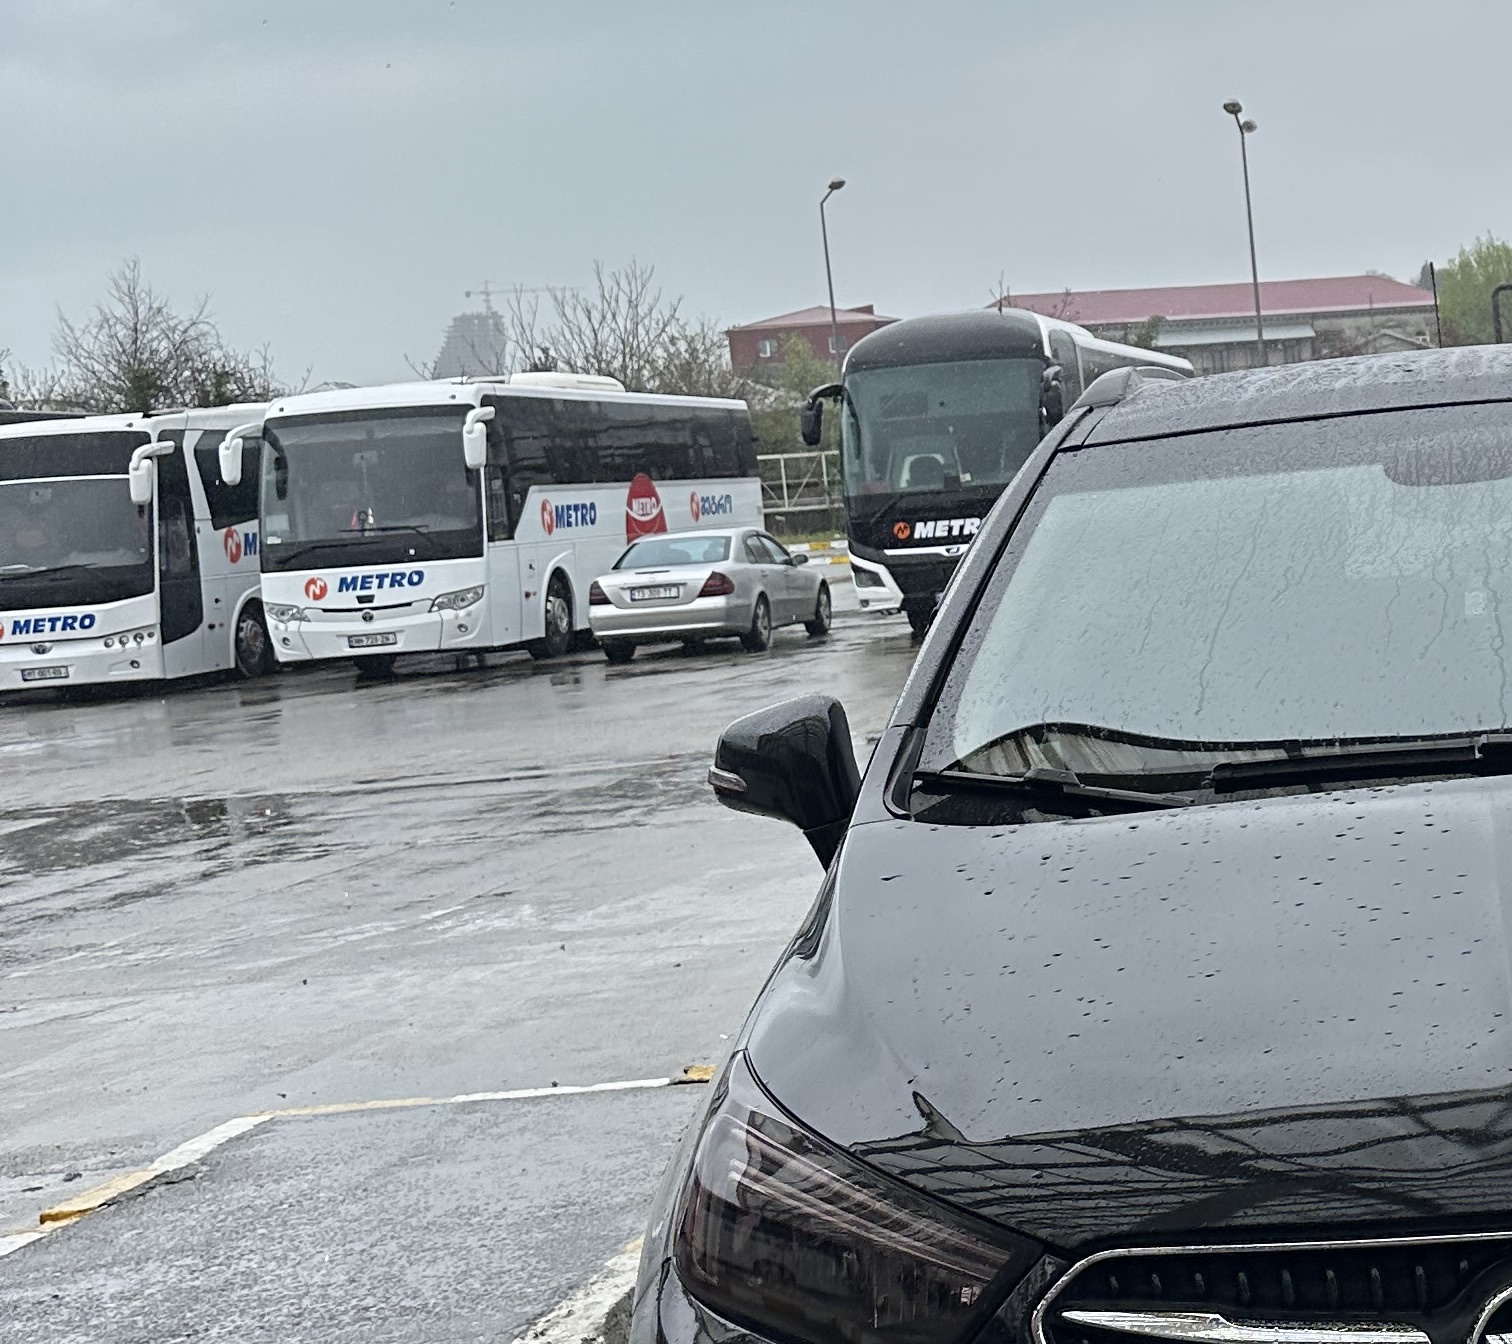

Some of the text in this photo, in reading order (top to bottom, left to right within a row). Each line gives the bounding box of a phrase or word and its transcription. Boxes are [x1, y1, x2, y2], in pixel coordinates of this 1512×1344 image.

[554, 501, 598, 529] METRO
[913, 517, 982, 540] METR
[337, 570, 425, 593] METRO
[11, 613, 97, 636] METRO
